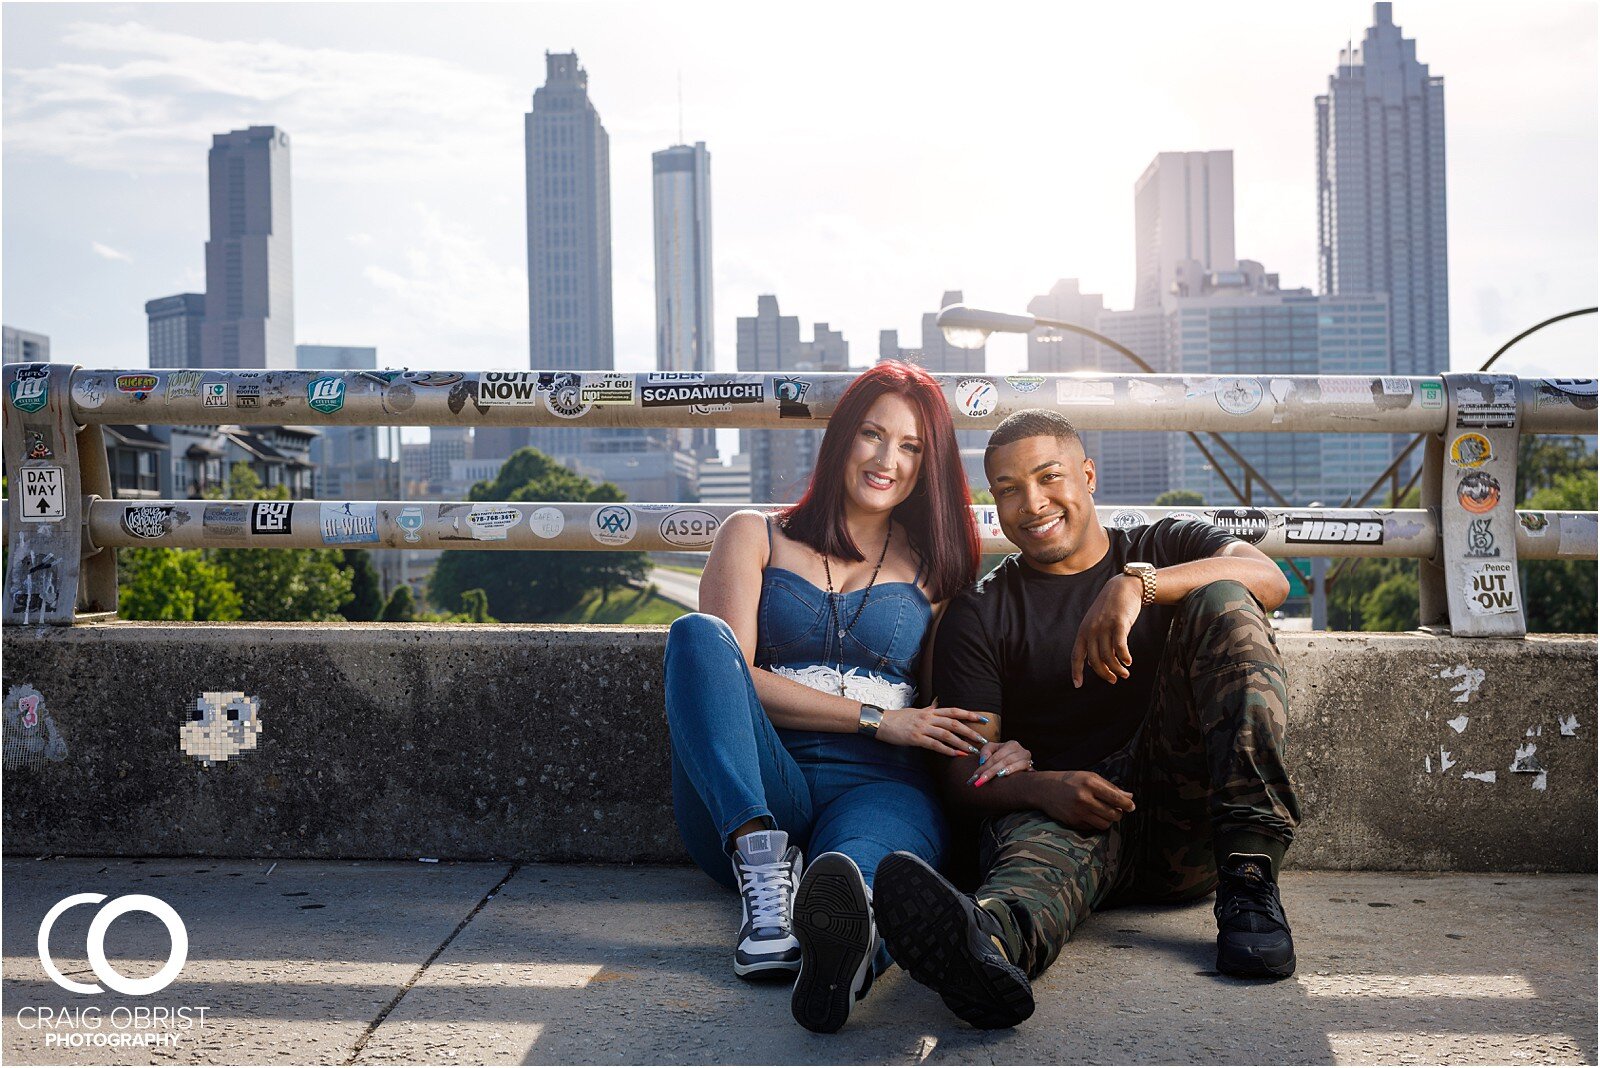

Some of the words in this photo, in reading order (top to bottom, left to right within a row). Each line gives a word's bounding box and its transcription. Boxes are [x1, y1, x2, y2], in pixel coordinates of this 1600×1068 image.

[486, 372, 527, 382] OUT
[482, 383, 534, 399] NOW
[583, 391, 600, 400] NO!
[643, 387, 761, 401] SCADAMUCHI
[205, 397, 227, 406] ATL
[28, 471, 55, 483] DAT
[28, 484, 57, 496] WAY
[257, 503, 289, 514] BUT
[471, 514, 516, 522] 678-768-3611
[1217, 517, 1266, 528] HILLMAN
[325, 516, 374, 537] HI-WIRE
[1485, 563, 1511, 572] Pence
[1472, 591, 1513, 609] OW
